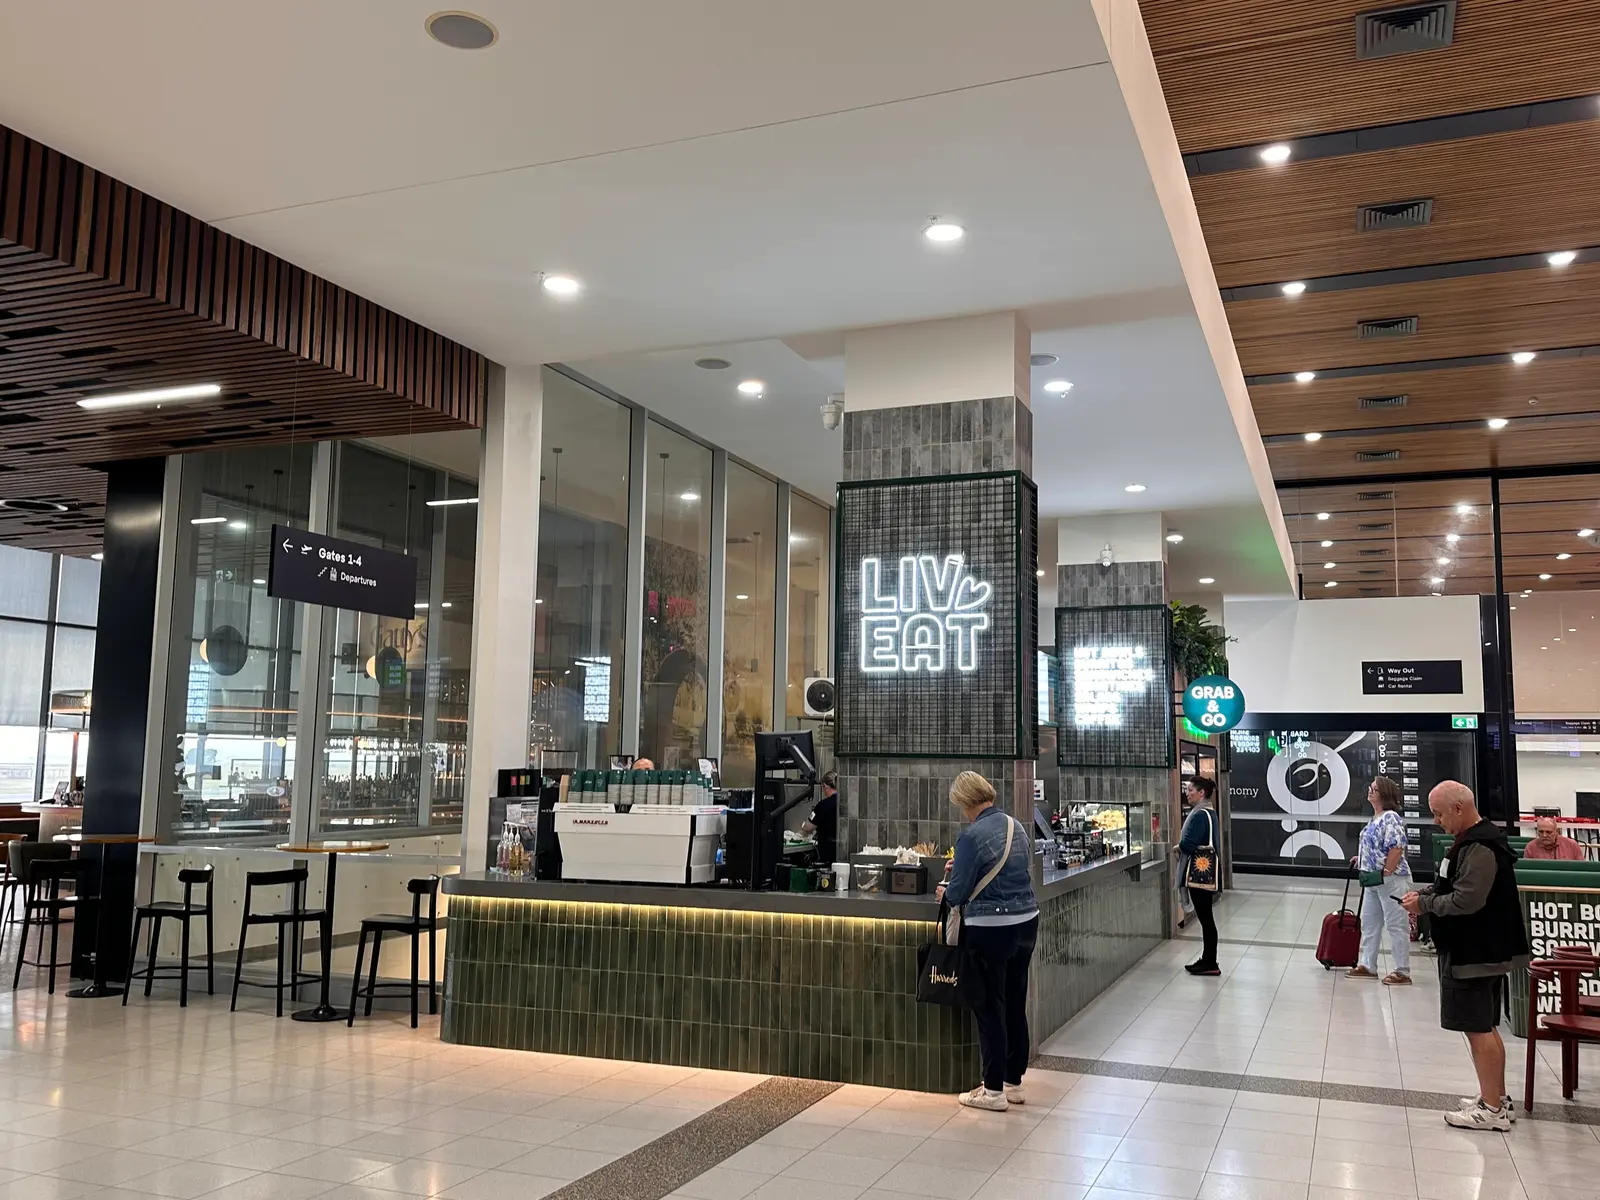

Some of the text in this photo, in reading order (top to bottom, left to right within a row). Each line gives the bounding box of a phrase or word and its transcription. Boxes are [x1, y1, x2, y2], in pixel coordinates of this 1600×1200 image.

[318, 547, 363, 567] Gates 1-4
[340, 571, 377, 588] Departures
[861, 613, 989, 672] EAT
[1387, 667, 1401, 675] Way
[1191, 685, 1235, 700] GRAB
[1206, 700, 1220, 713] &
[1200, 713, 1226, 727] GO
[1530, 901, 1573, 920] HOT
[929, 965, 958, 987] Harrods
